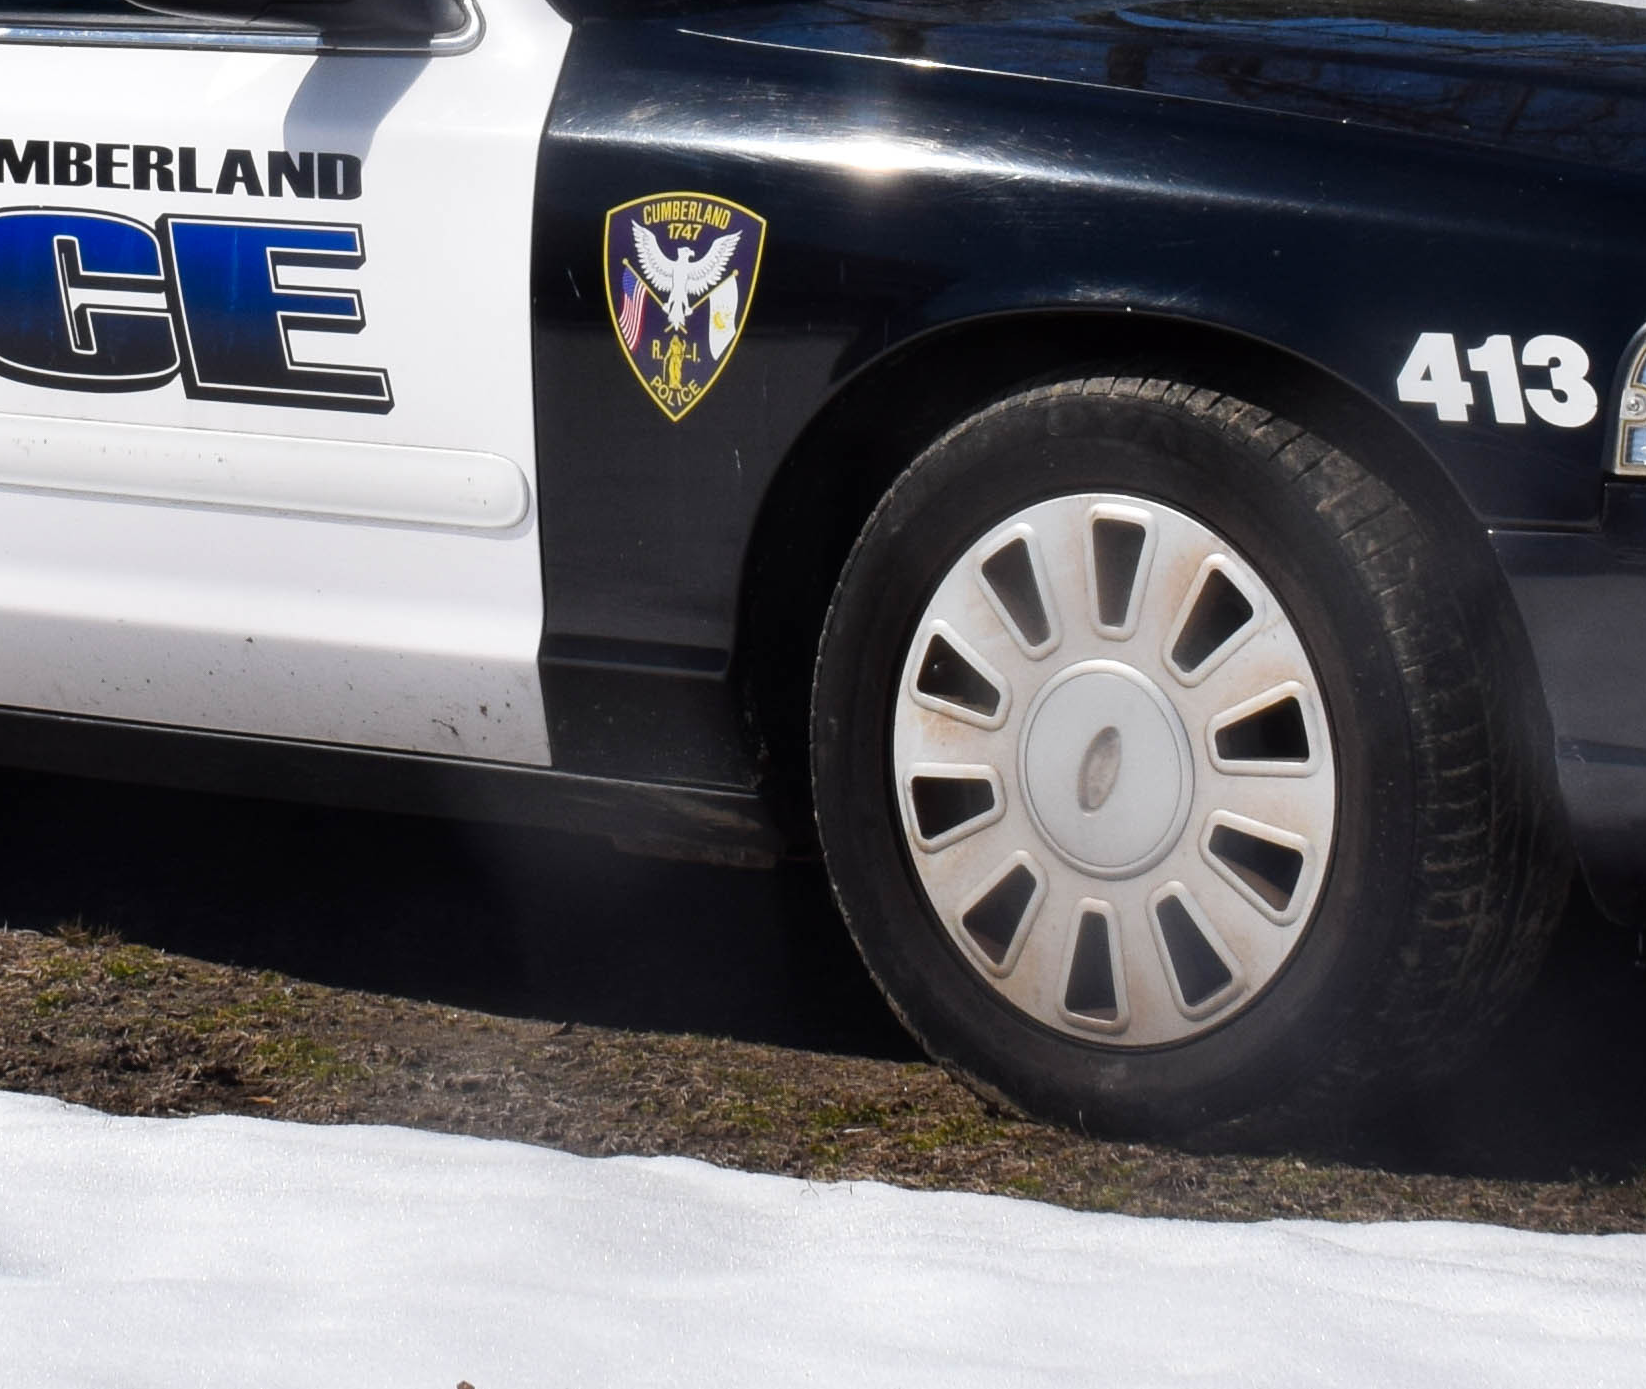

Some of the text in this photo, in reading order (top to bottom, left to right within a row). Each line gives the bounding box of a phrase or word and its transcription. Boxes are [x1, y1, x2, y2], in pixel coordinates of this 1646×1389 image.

[643, 200, 732, 230] CUMBERLAND
[667, 222, 703, 241] 1747
[650, 374, 702, 407] POLICE
[1396, 332, 1598, 428] 413
